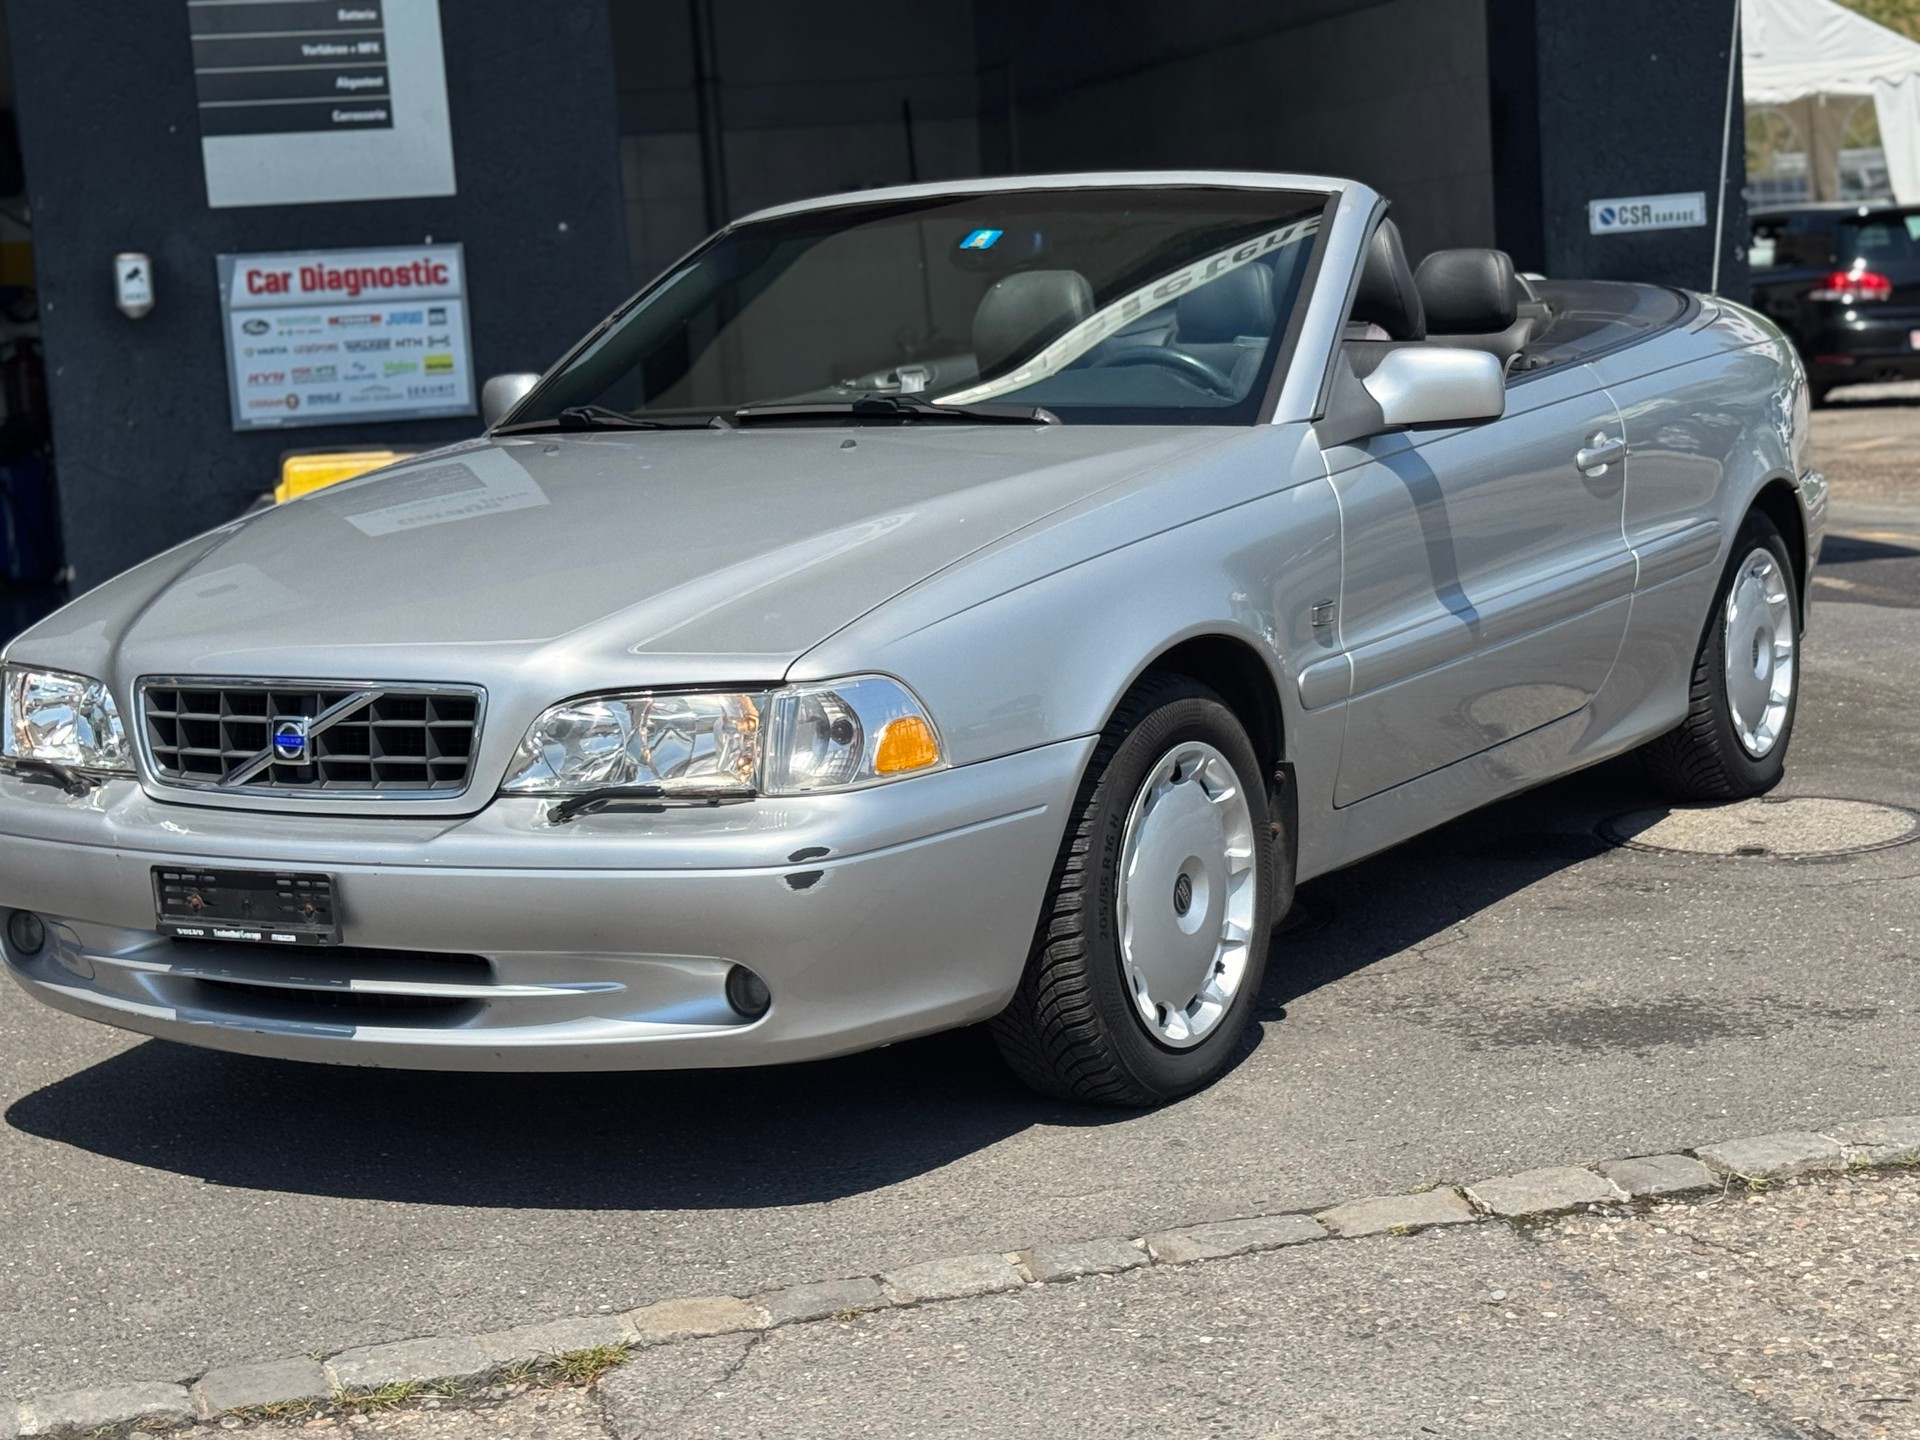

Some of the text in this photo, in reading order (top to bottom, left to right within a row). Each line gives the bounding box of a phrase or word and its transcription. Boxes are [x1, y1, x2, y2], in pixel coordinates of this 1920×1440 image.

[1618, 205, 1695, 225] CSR GARAGE
[246, 258, 448, 296] Car Diagnostic
[1099, 814, 1119, 941] 205/55 R 16 H
